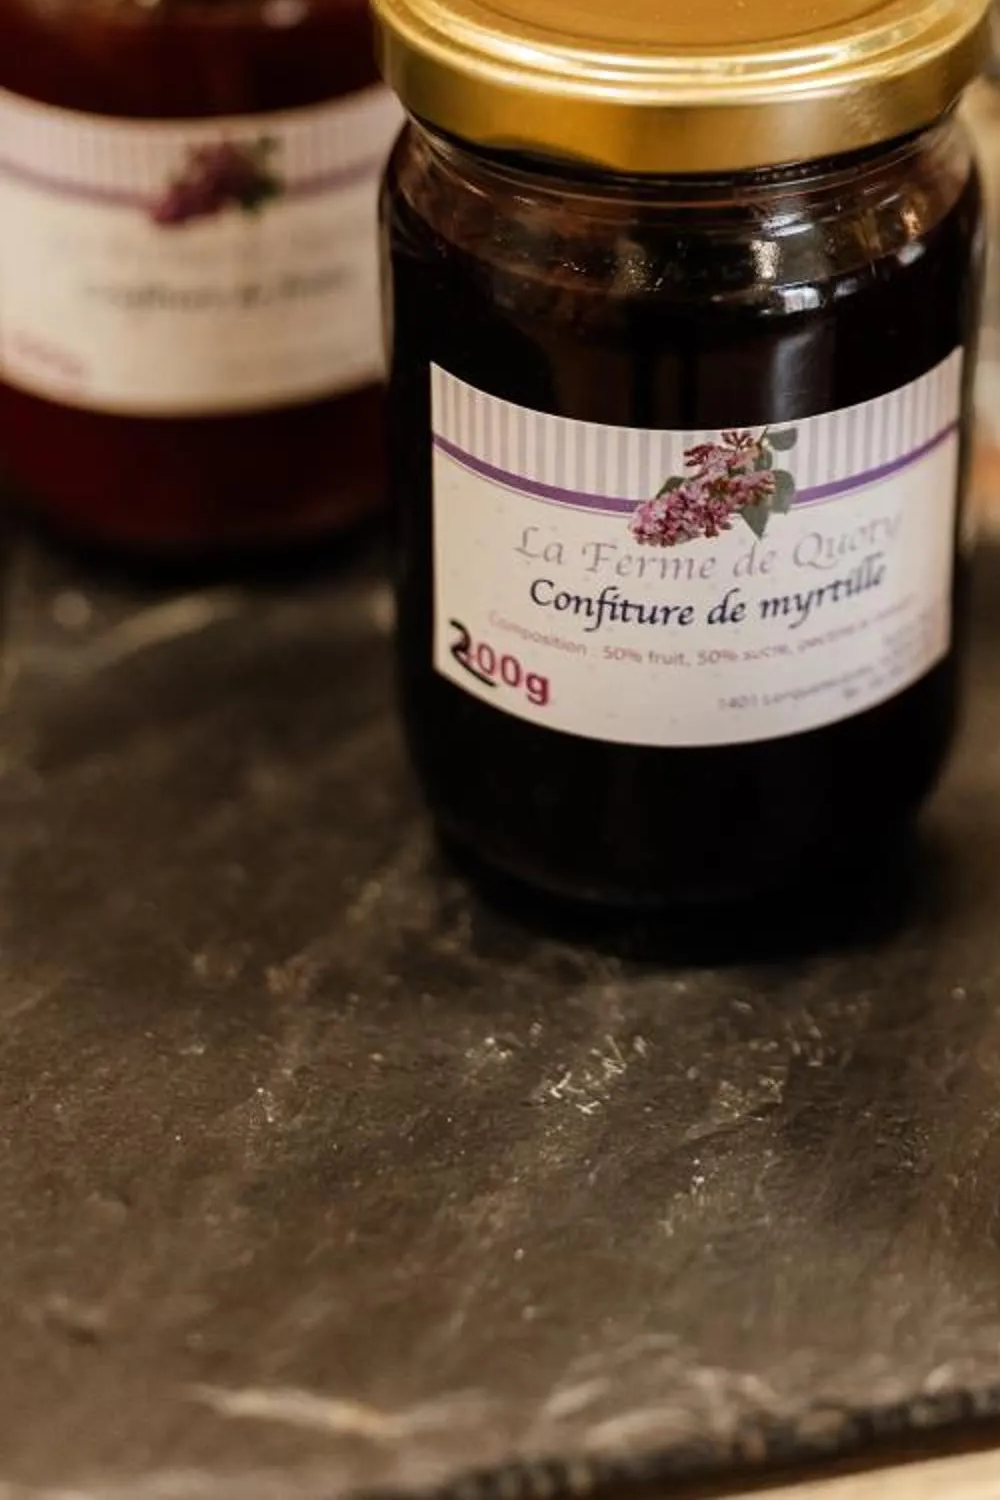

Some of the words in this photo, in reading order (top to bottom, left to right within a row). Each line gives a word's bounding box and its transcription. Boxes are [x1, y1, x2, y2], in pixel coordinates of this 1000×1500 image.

[512, 525, 564, 566] La
[581, 541, 717, 581] Ferme
[732, 539, 773, 577] de
[529, 577, 695, 632] Confiture
[706, 586, 748, 627] de
[759, 550, 888, 630] myrtille
[449, 617, 550, 707] 200g
